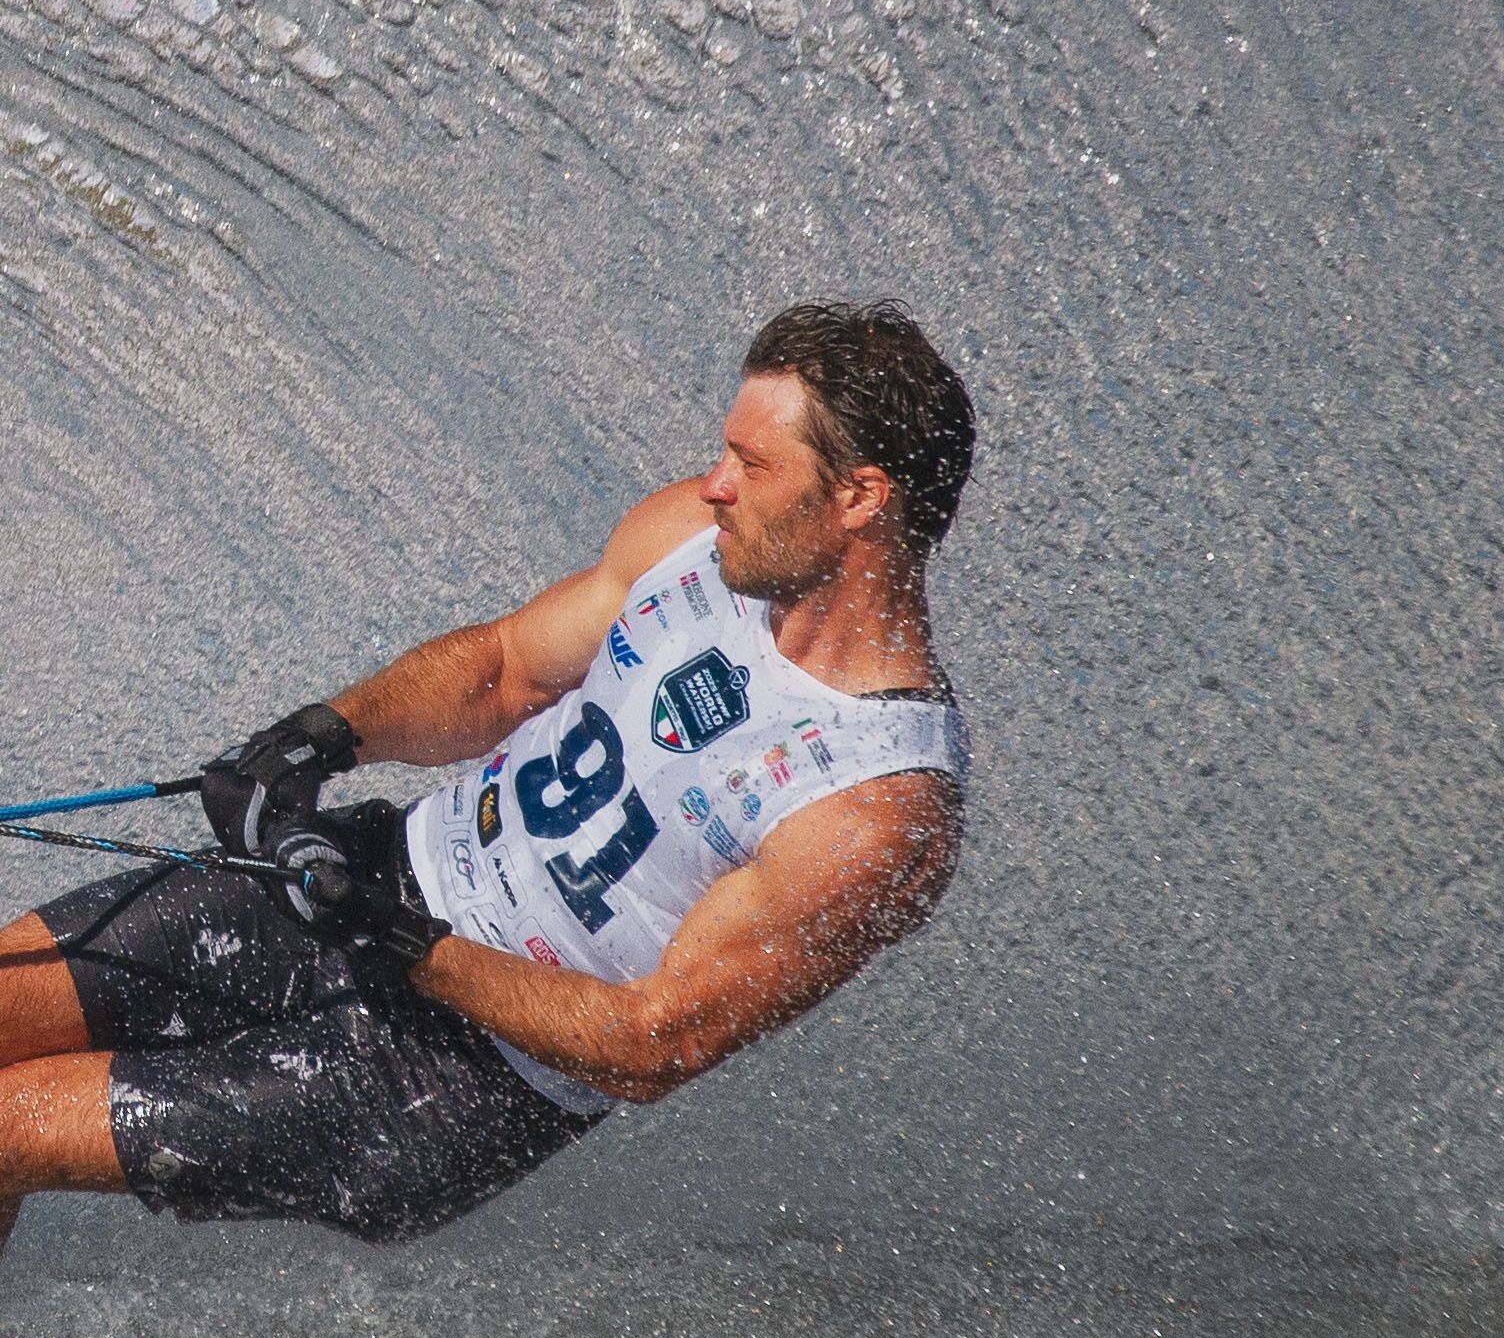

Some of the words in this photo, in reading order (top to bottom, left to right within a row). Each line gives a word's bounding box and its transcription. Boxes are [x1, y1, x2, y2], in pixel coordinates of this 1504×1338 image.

[685, 678, 714, 731] WATERSKI
[693, 672, 724, 726] WORLD
[515, 701, 660, 935] 91
[529, 936, 557, 965] RDS
